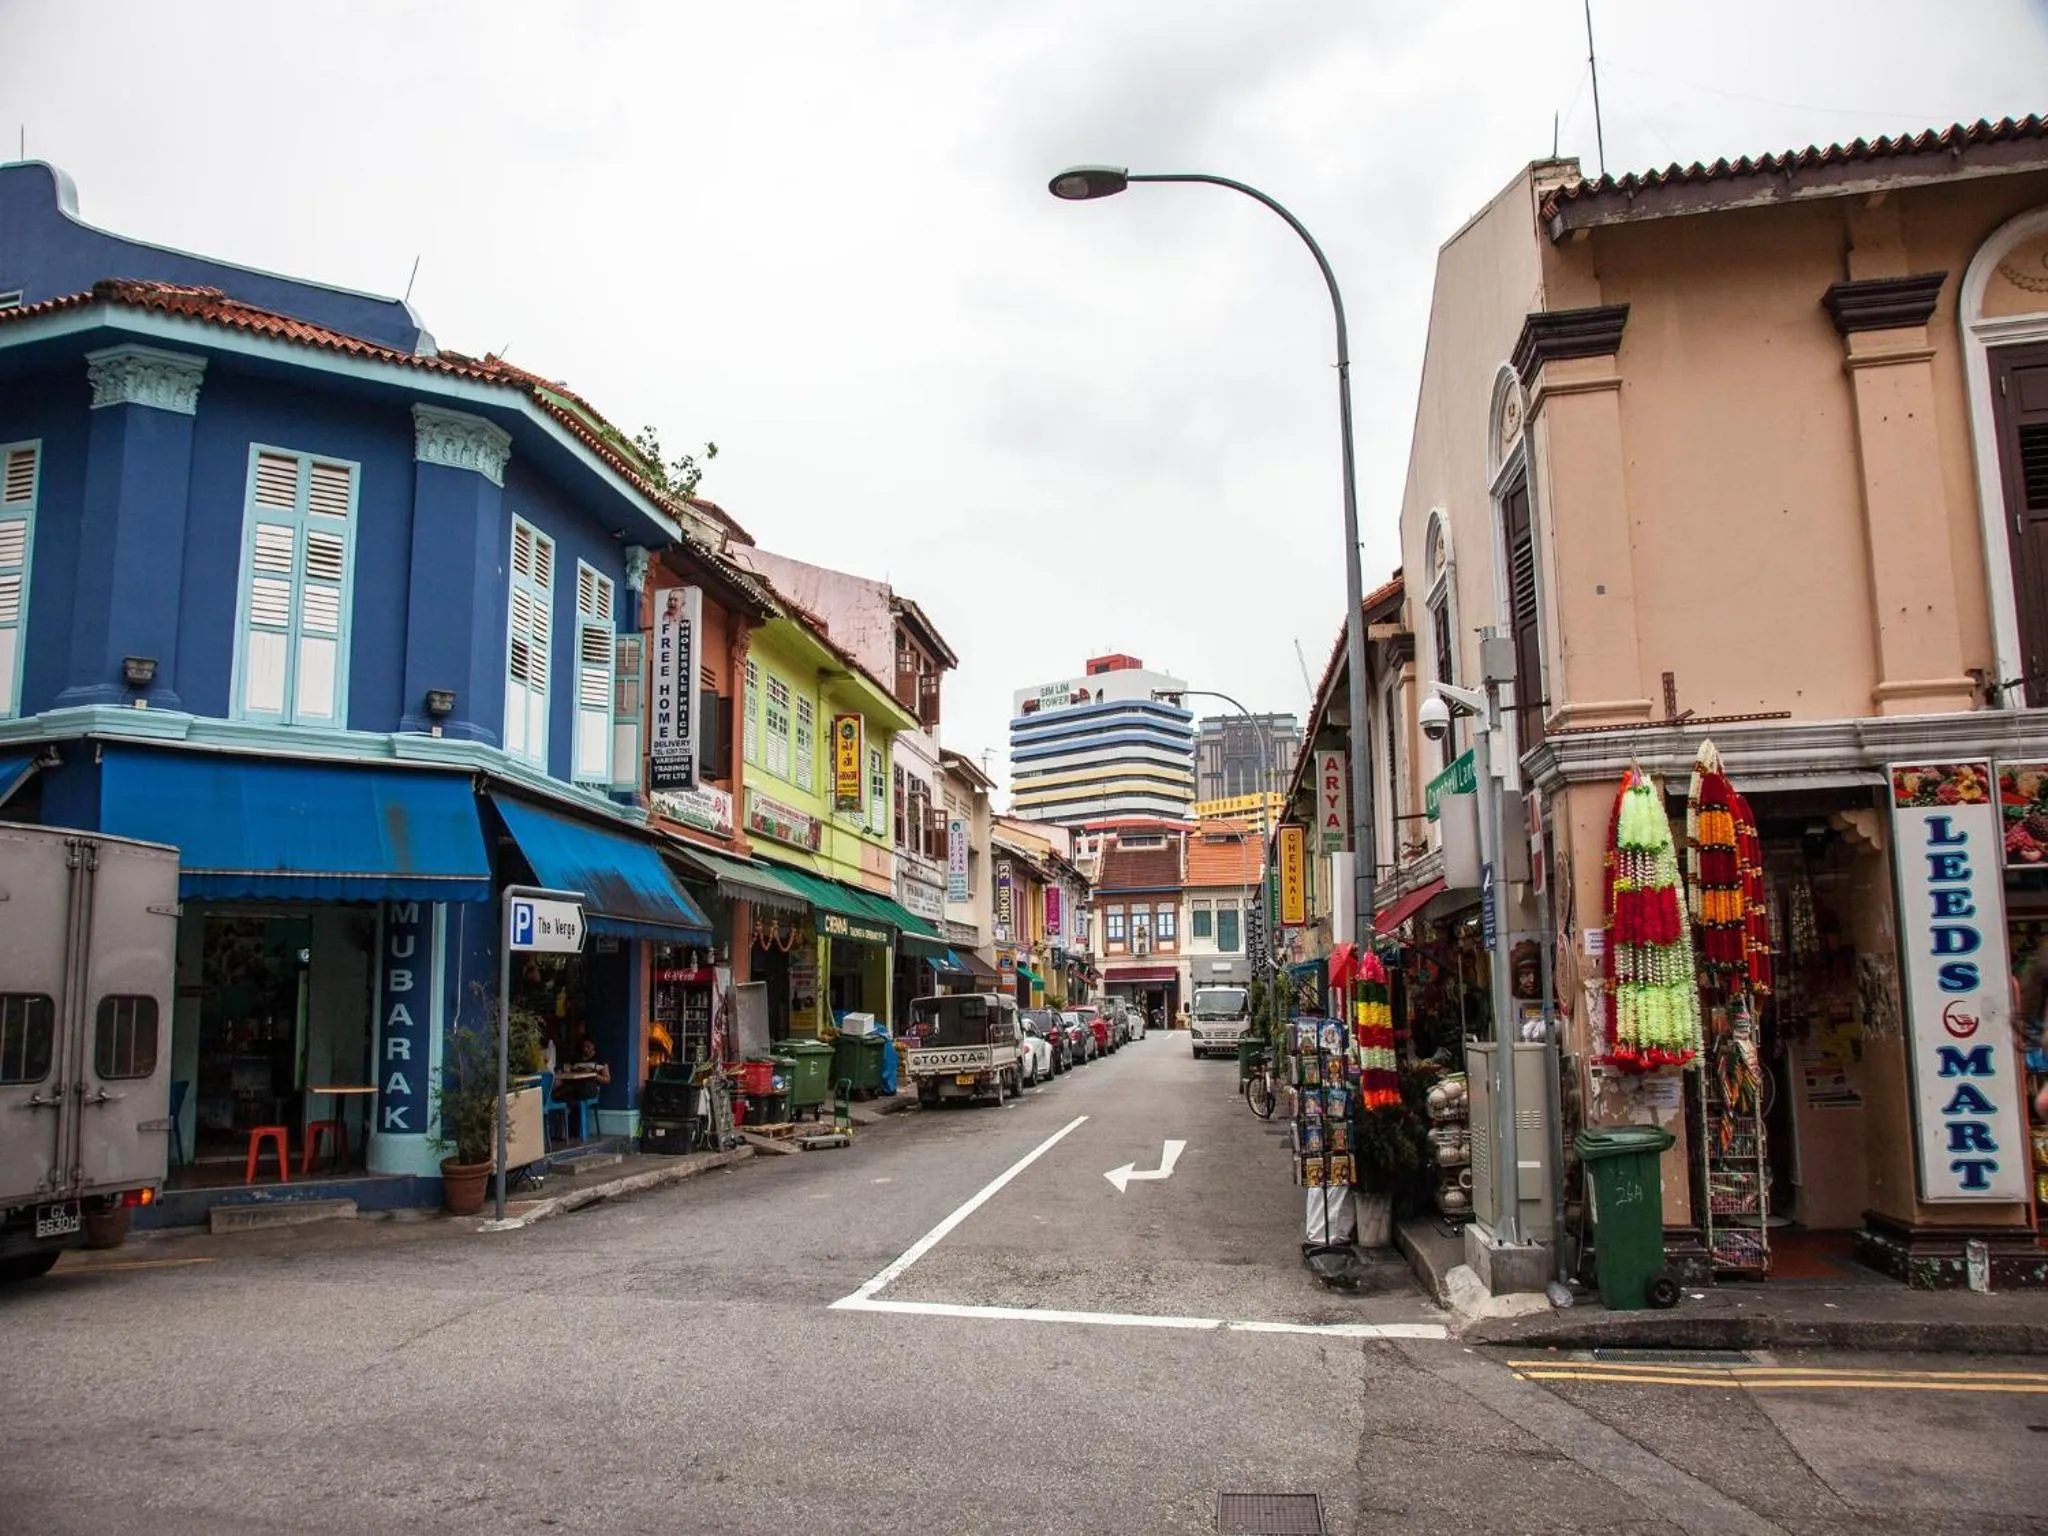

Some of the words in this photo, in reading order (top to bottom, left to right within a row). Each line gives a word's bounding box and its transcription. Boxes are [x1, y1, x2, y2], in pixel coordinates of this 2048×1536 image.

[660, 623, 672, 677] FREE
[678, 620, 691, 692] WHOLESALE
[1040, 685, 1054, 697] SIM
[1056, 682, 1070, 694] LIM
[1040, 693, 1070, 708] TOWER
[658, 684, 671, 738] HOME
[676, 696, 688, 736] PRICE
[653, 739, 691, 748] DELIVERY
[654, 764, 690, 772] TRADINGS
[672, 772, 687, 780] LTD
[1325, 756, 1341, 828] ARYA
[999, 865, 1010, 879] 33
[1288, 833, 1297, 905] CHENNAI
[999, 886, 1010, 923] DHOBI
[1925, 815, 1980, 994] LEEDS
[516, 905, 531, 943] P
[538, 917, 551, 935] The
[555, 918, 576, 940] Verge
[384, 902, 420, 1130] MUBARAK
[920, 1053, 977, 1065] TOYOTA
[1937, 1044, 1999, 1190] MART
[51, 1204, 66, 1219] GX
